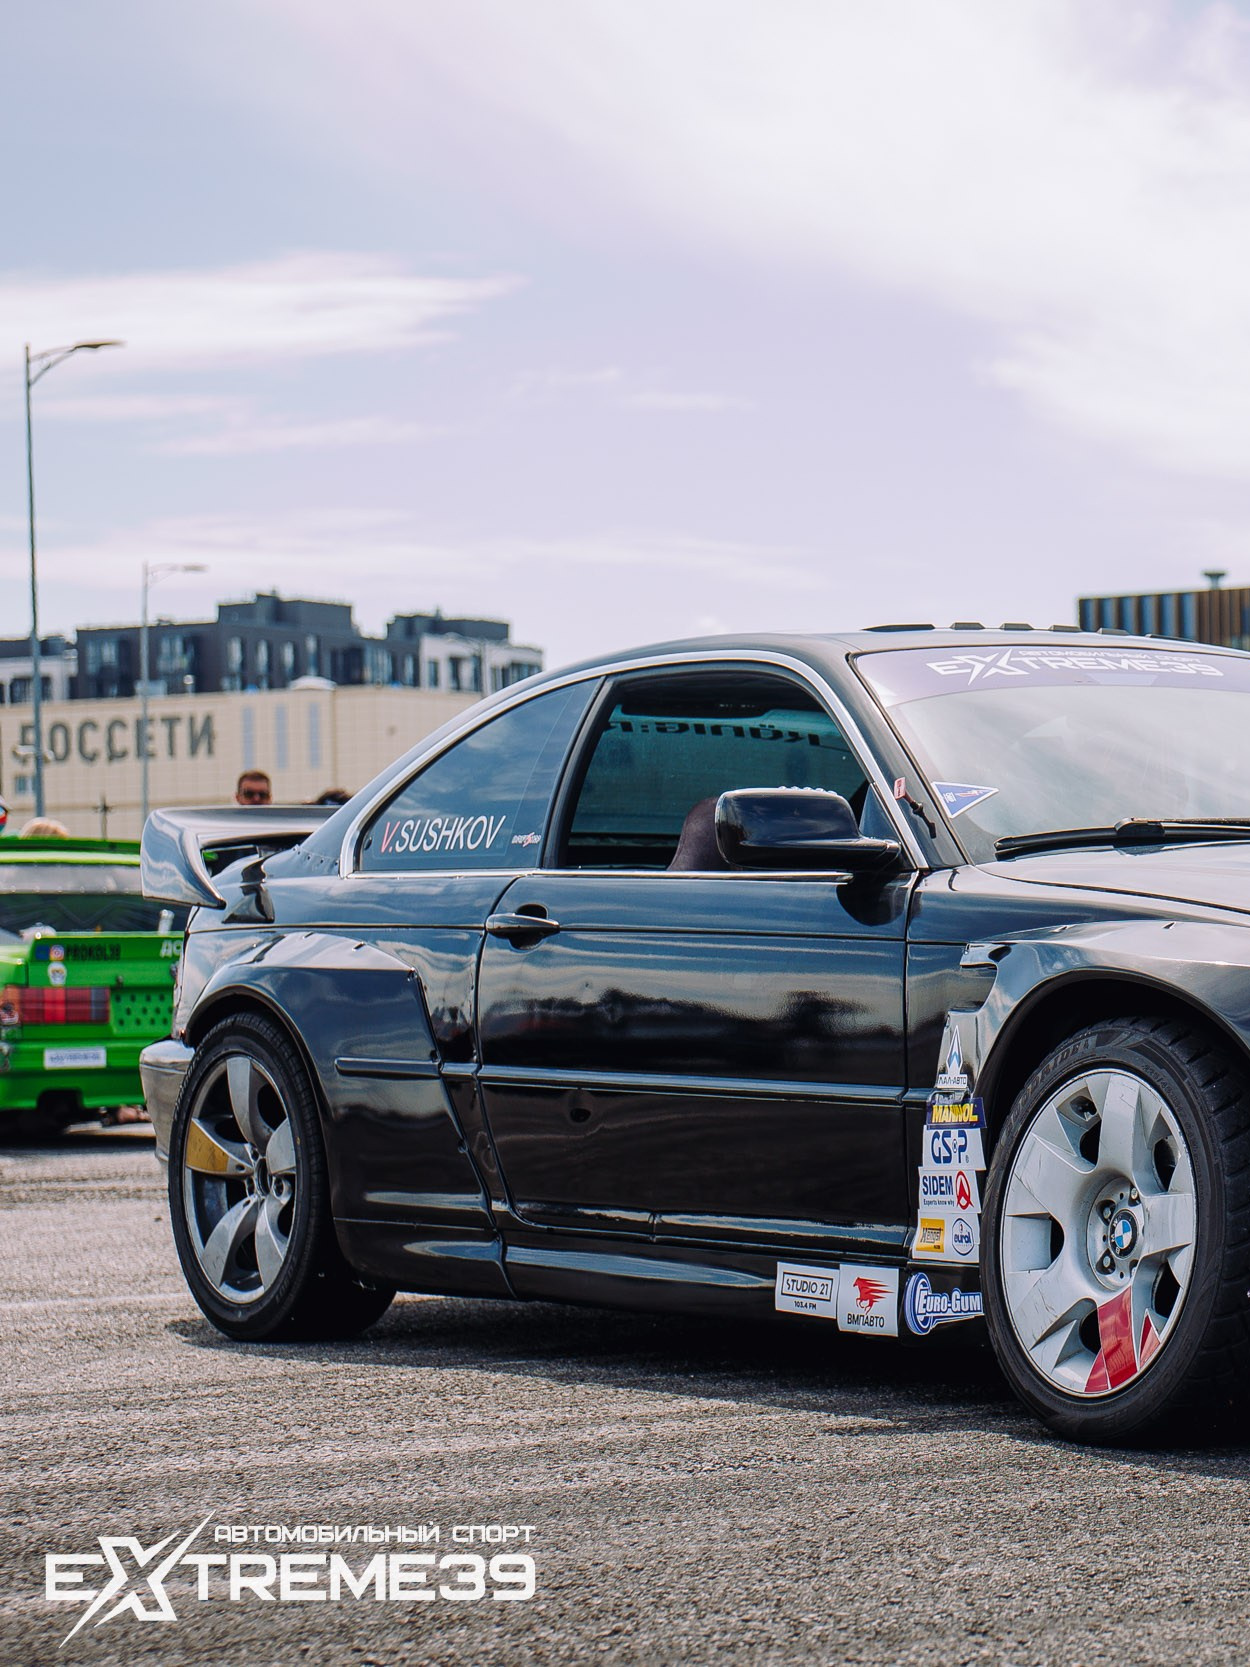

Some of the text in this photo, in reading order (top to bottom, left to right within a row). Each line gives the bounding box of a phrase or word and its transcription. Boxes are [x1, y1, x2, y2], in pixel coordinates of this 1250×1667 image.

[931, 1103, 979, 1124] MANNOL
[922, 1175, 954, 1196] SIDEM
[786, 1278, 829, 1296] STUDIO 21
[793, 1300, 817, 1311] 103.4 FM
[847, 1312, 885, 1328] ВМПАВТО
